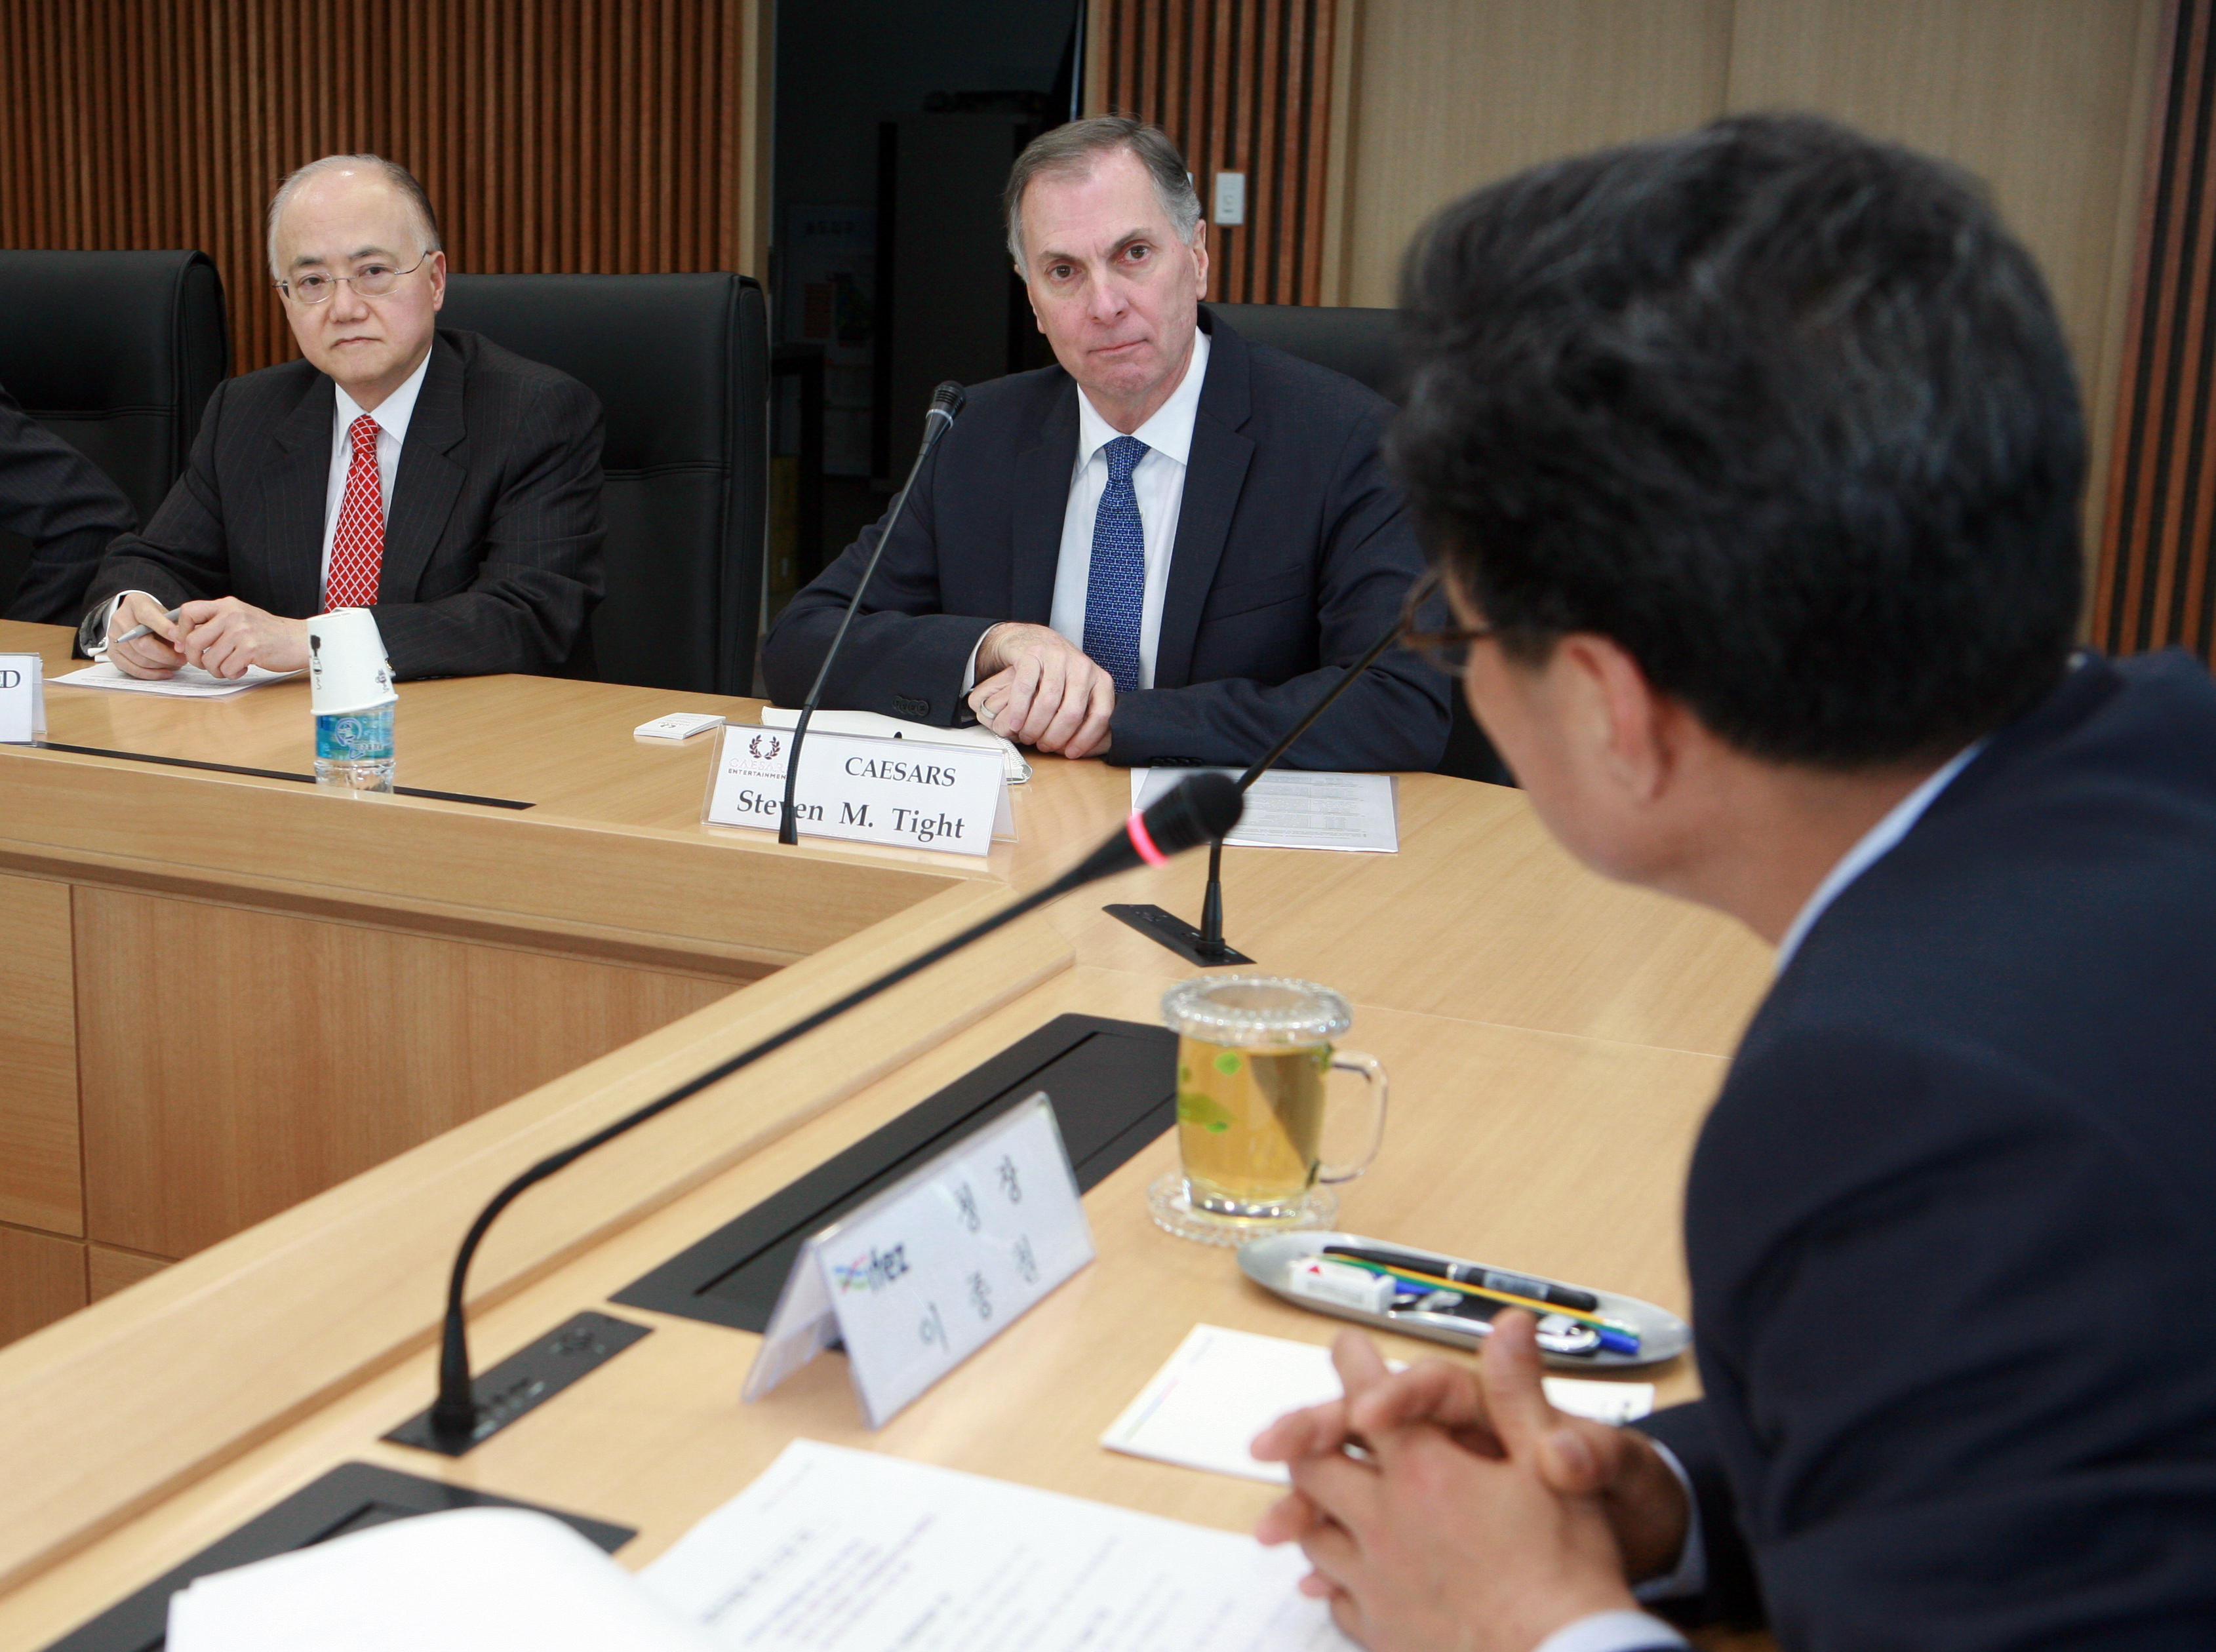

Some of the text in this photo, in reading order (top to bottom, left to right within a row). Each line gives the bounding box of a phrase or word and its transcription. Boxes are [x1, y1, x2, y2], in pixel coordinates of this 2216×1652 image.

[728, 757, 787, 774] CAESAR
[728, 768, 787, 780] ENTERTAINMEN
[844, 757, 957, 787] CAESARS
[736, 789, 966, 843] Steen M. Tight
